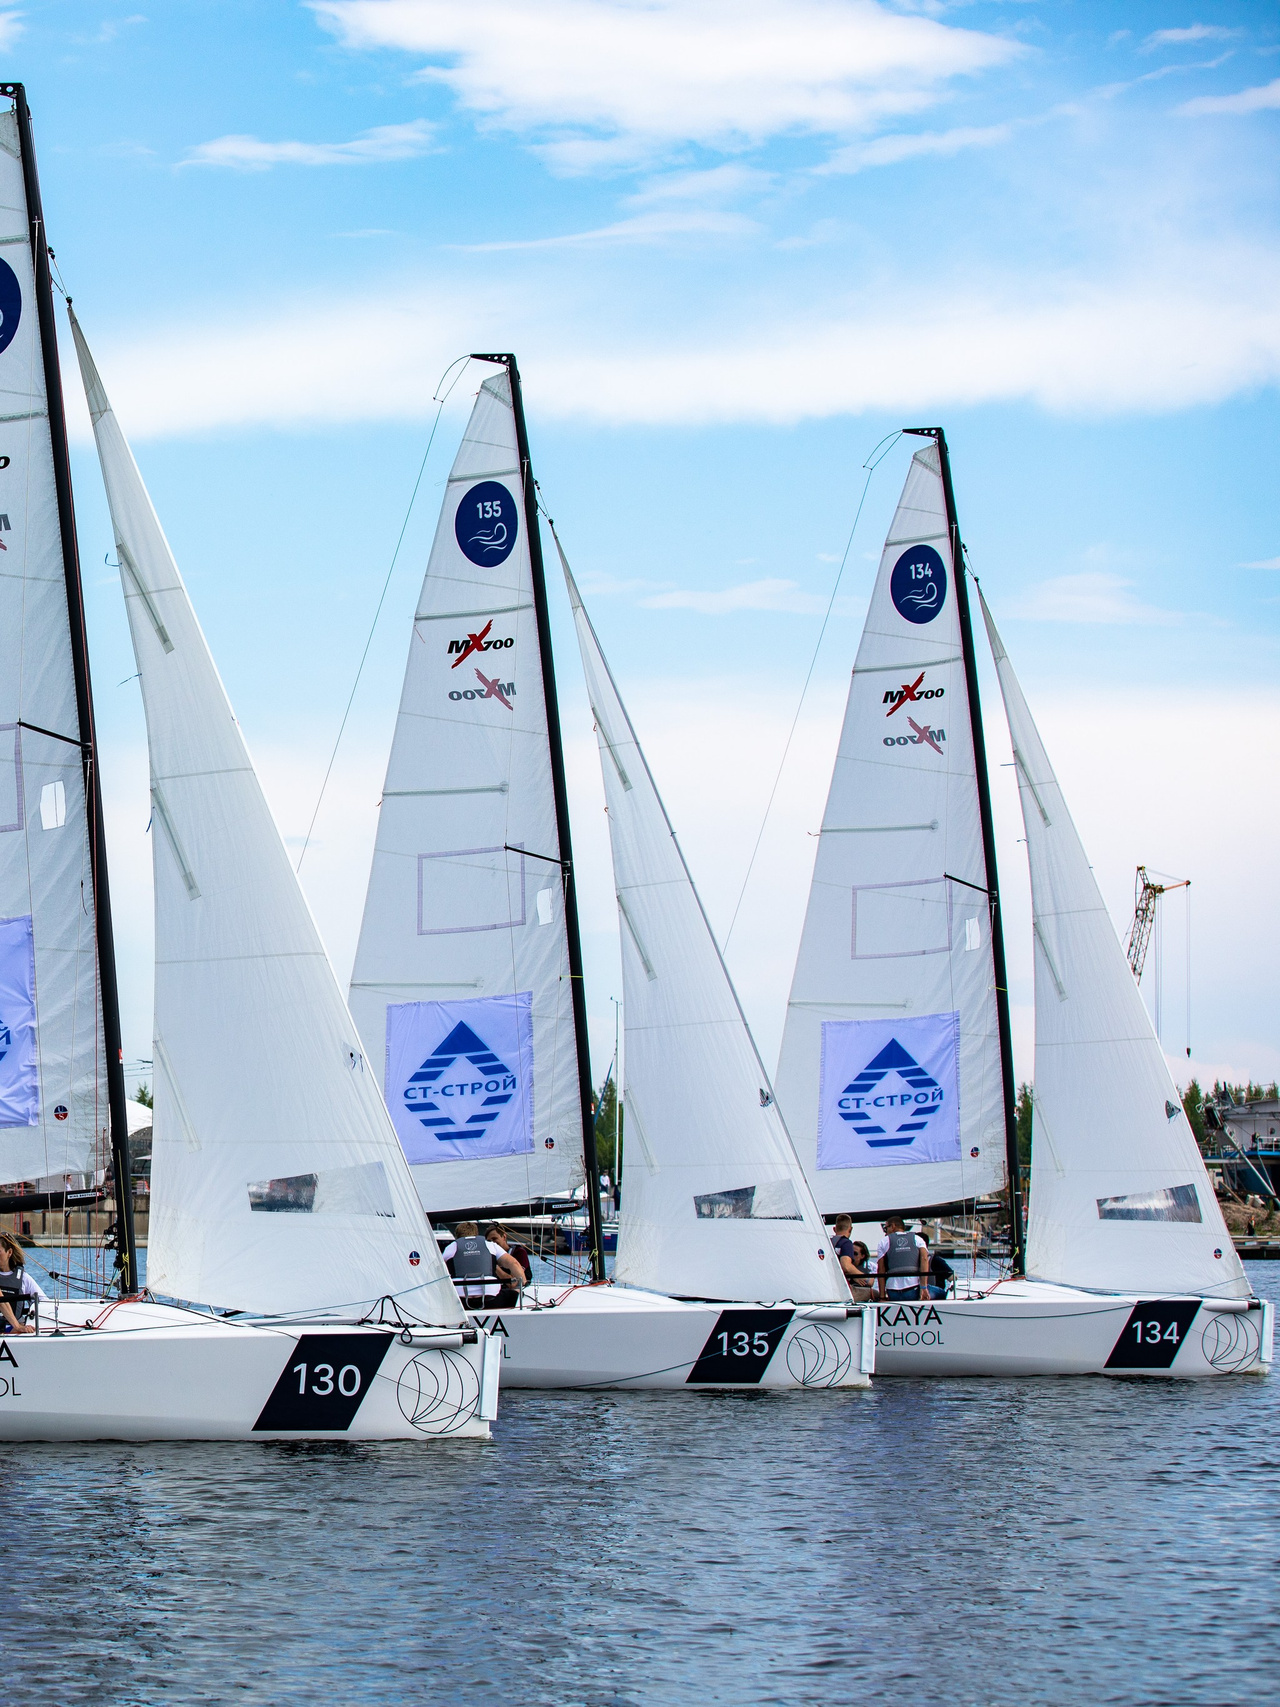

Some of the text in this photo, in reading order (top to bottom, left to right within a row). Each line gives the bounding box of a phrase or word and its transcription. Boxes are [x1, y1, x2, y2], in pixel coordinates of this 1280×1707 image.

[477, 500, 502, 519] 135
[910, 563, 933, 580] 134
[447, 619, 514, 669] MX700
[882, 672, 945, 717] MX700
[403, 1074, 517, 1100] СТ-СТРОЙ
[837, 1087, 944, 1109] СТ-СТРОЙ
[876, 1304, 943, 1327] KAYA
[717, 1331, 770, 1357] 135
[1132, 1321, 1180, 1344] 134
[292, 1362, 362, 1397] 130
